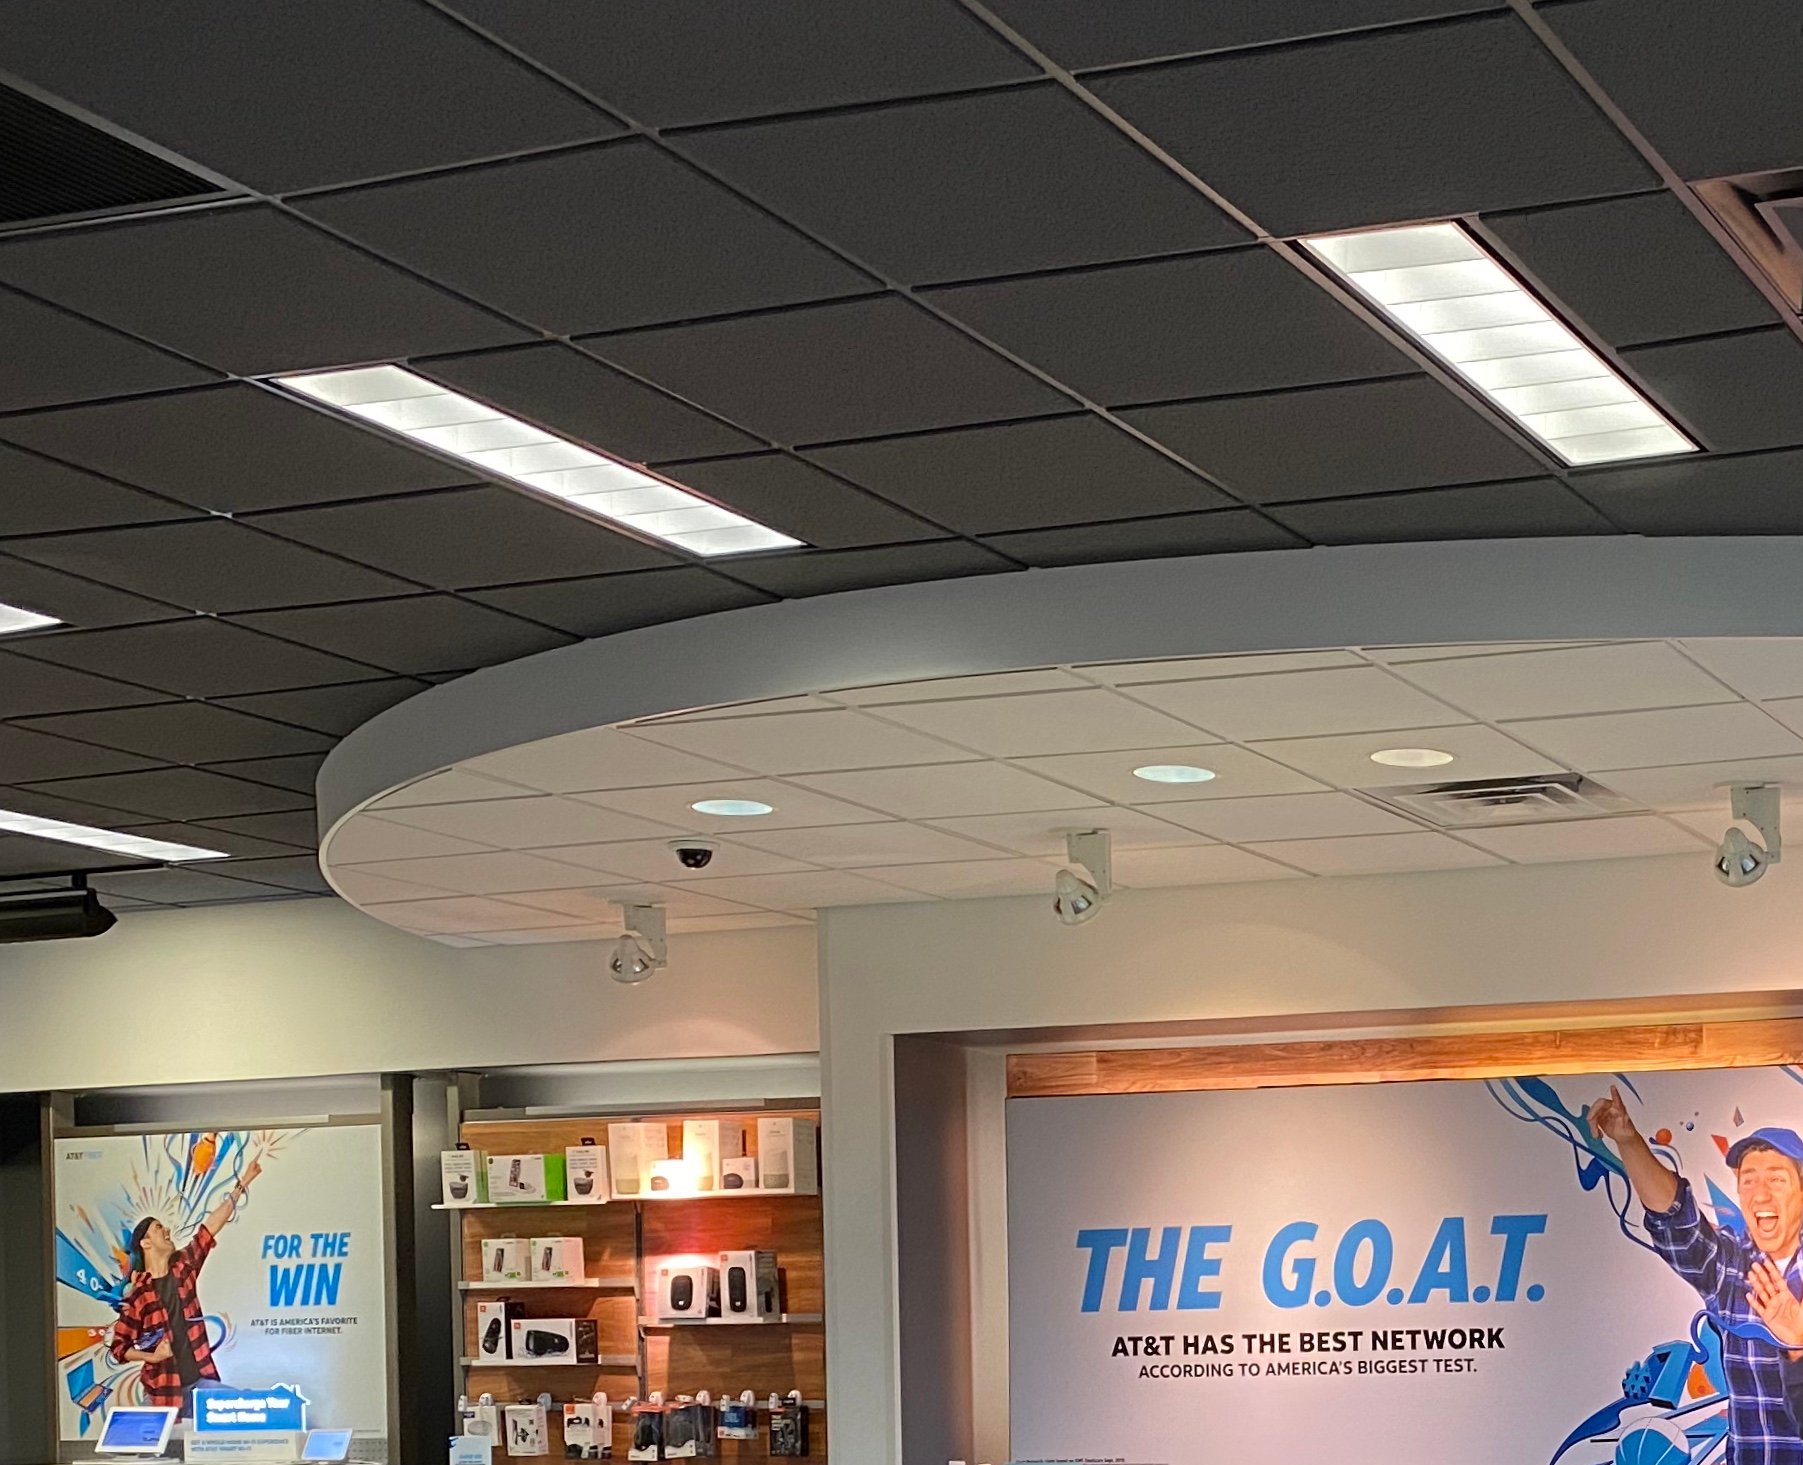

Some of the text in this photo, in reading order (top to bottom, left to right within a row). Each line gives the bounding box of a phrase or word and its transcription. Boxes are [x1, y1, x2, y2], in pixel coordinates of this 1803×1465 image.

[262, 1232, 352, 1260] FOR THE
[1075, 1214, 1548, 1313] THE G.O.A.T.
[269, 1263, 343, 1307] WIN
[250, 1319, 269, 1327] AT&T
[279, 1317, 319, 1326] AMERICA'S
[320, 1316, 358, 1326] FAVORITE
[264, 1327, 280, 1335] FOR
[282, 1327, 303, 1335] FIBER
[1112, 1328, 1505, 1357] AT&T HAS THE BEST NETWORK
[1139, 1358, 1477, 1379] ACCORDING TO AMERICA'S BIGGEST TEST.
